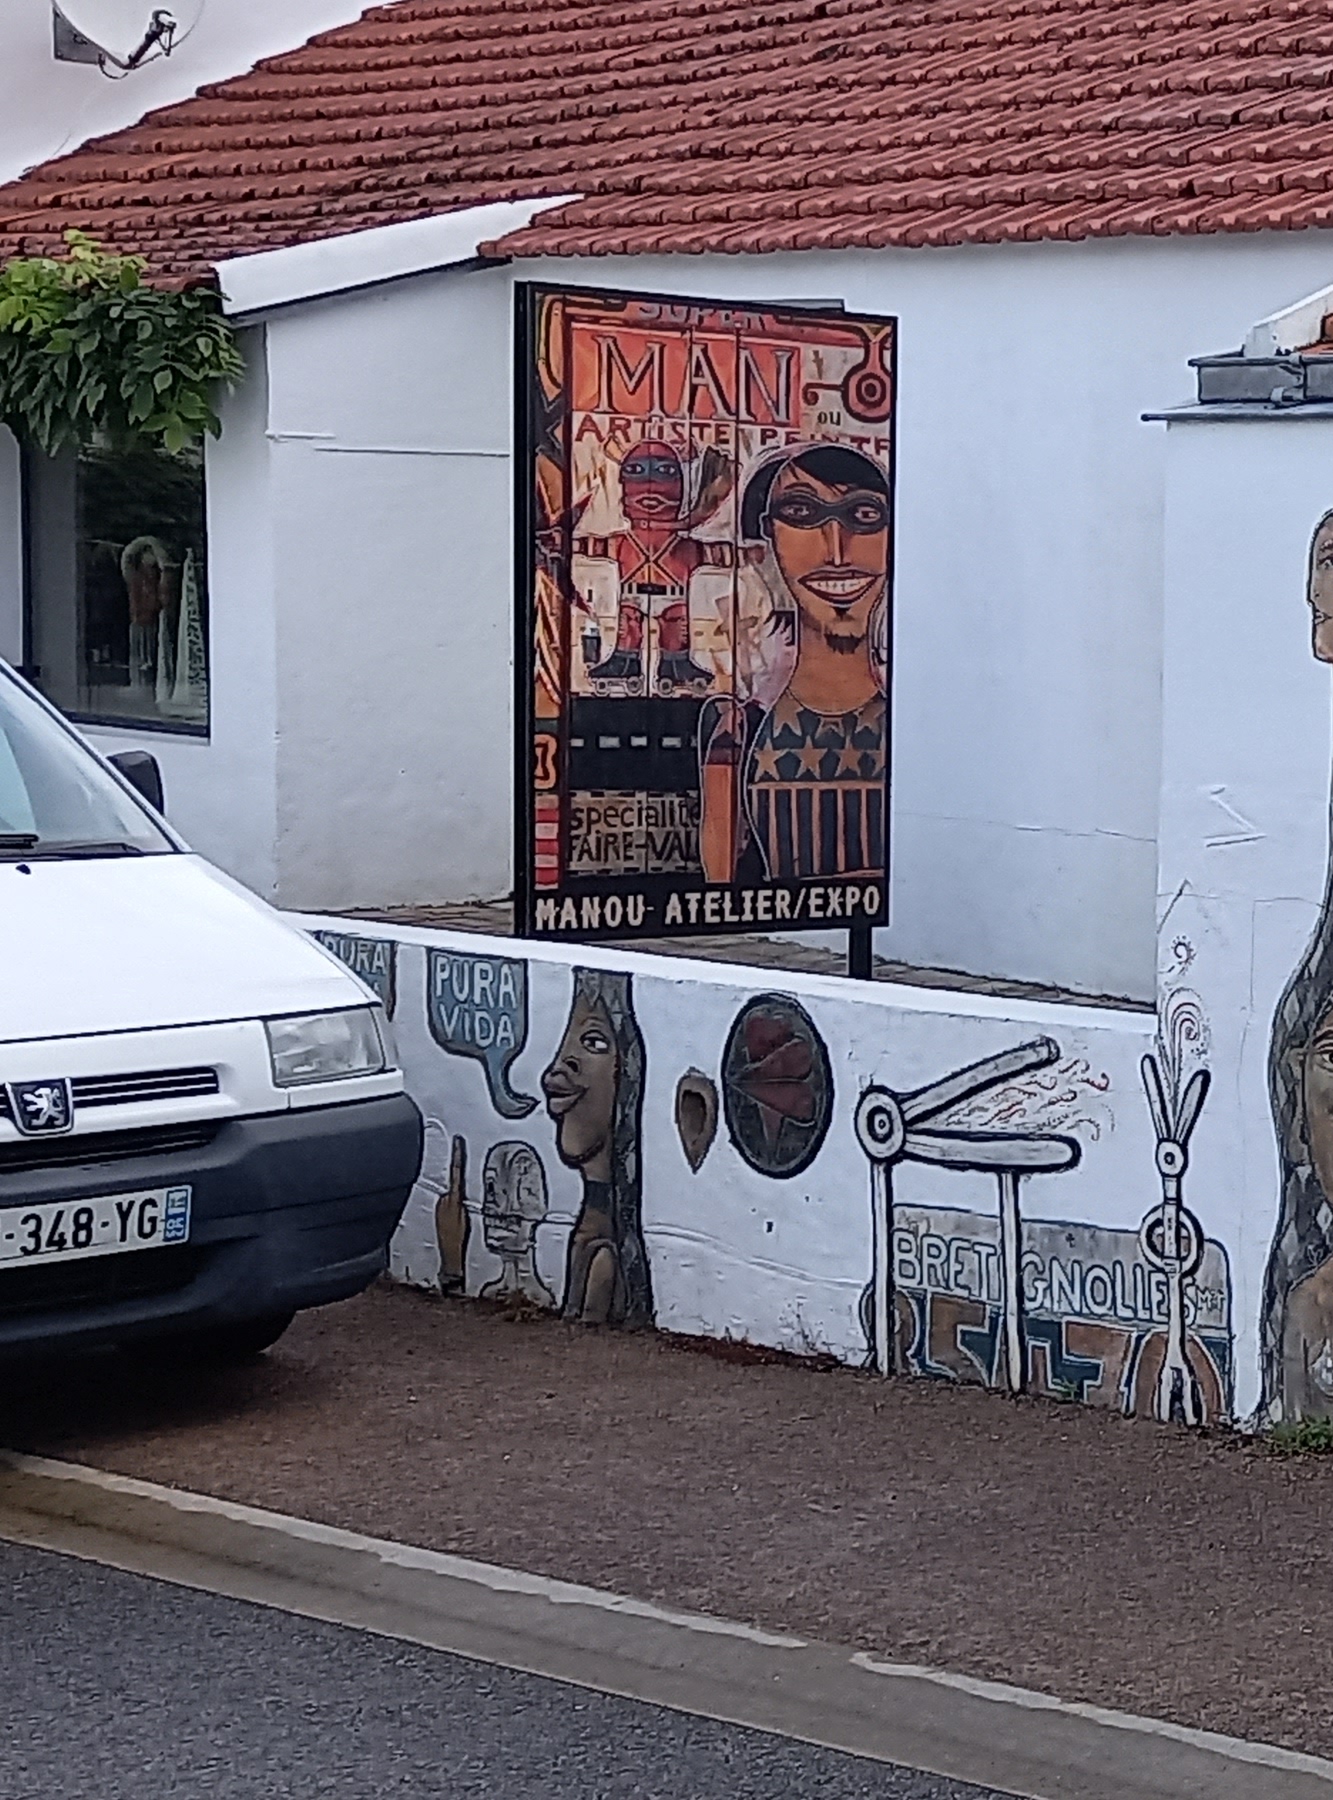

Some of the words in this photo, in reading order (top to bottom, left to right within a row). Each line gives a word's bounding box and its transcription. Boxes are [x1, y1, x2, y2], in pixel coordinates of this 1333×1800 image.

[592, 333, 796, 423] MAN
[664, 885, 881, 926] ATELIER/EXPO
[434, 955, 517, 1009] PURA
